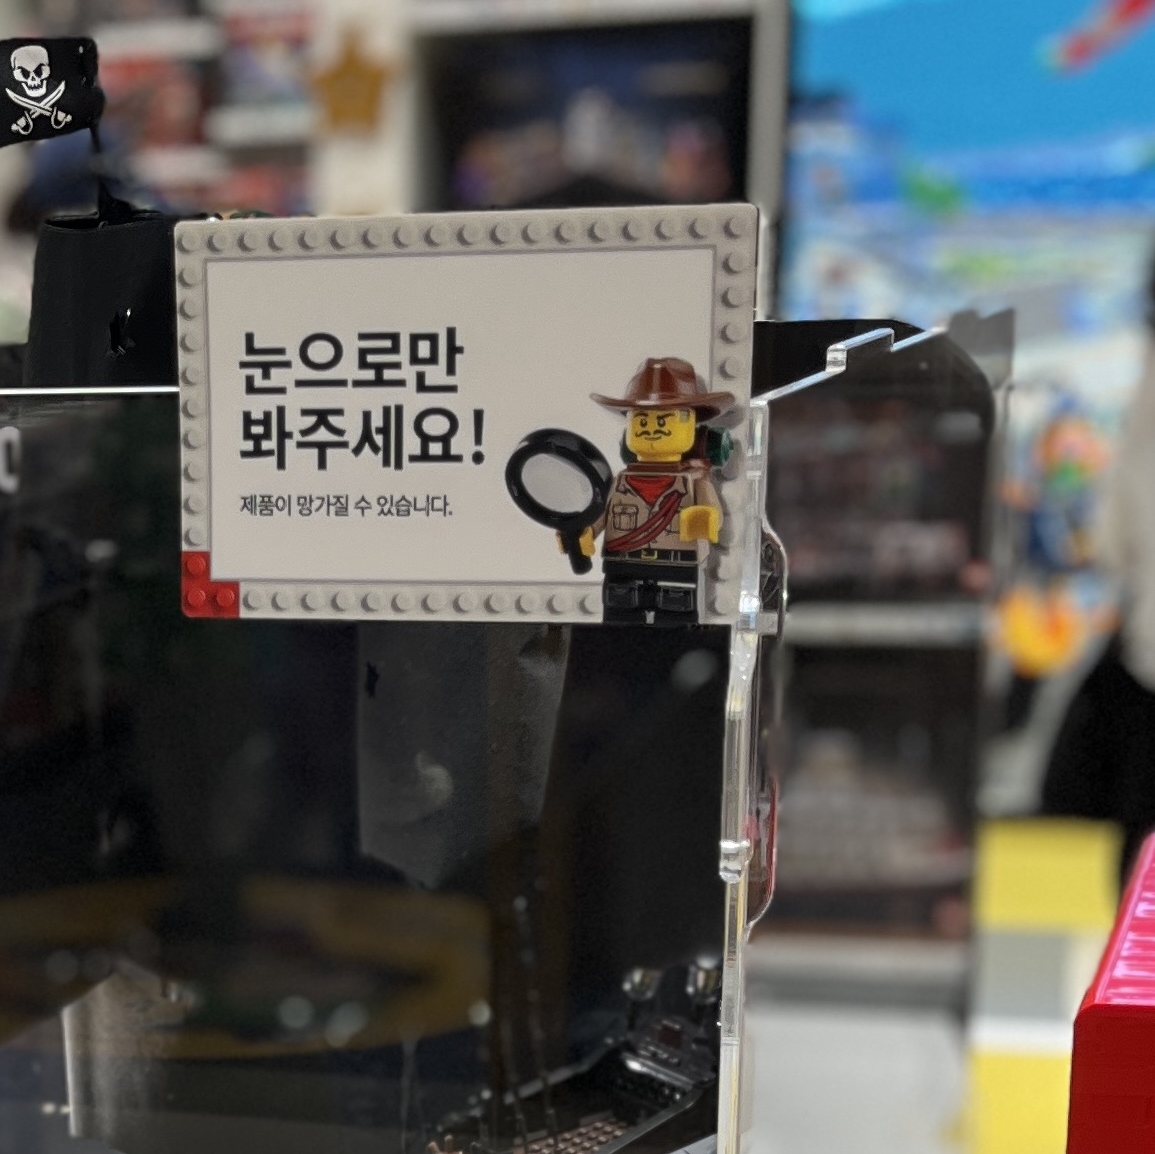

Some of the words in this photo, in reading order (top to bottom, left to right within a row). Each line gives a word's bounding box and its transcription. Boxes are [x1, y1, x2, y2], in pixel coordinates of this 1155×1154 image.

[238, 326, 465, 396] 눈으로만
[240, 405, 485, 471] 봐주세요!
[240, 495, 291, 517] 제품이
[297, 495, 349, 517] 망가질
[354, 495, 372, 517] 수
[377, 494, 453, 517] 있습니다.
